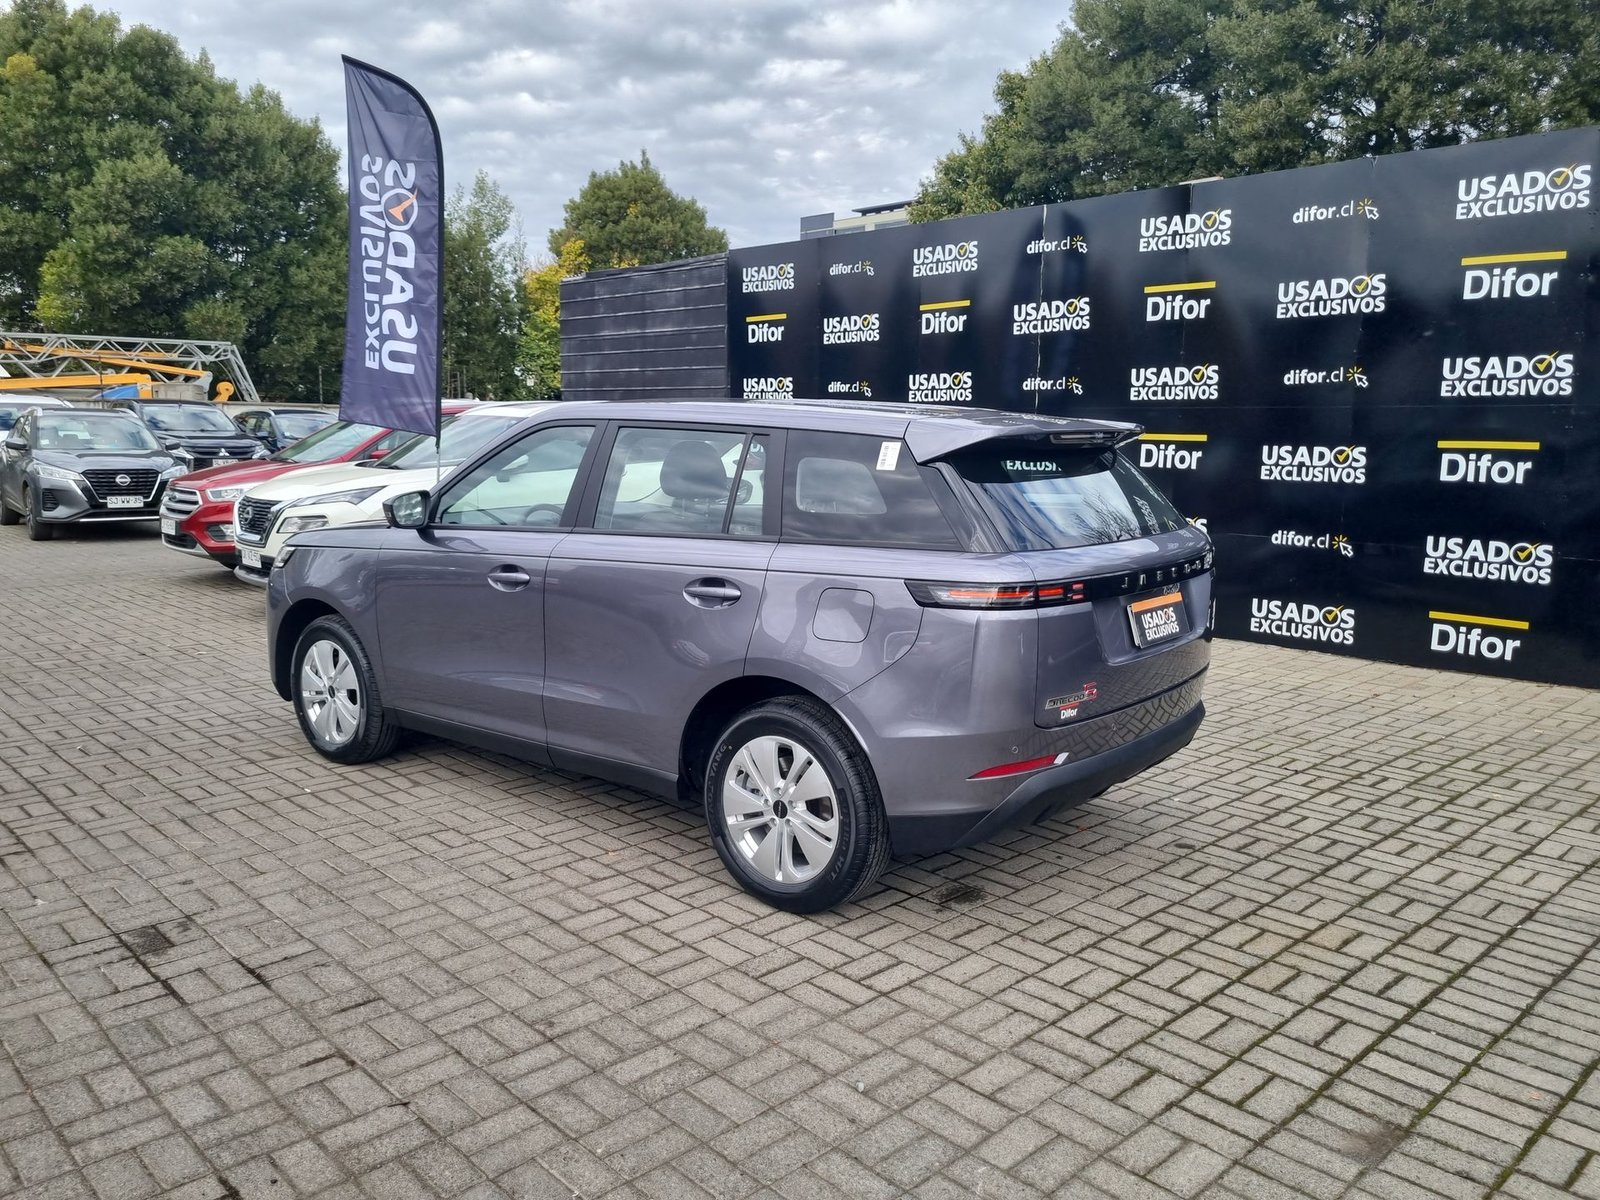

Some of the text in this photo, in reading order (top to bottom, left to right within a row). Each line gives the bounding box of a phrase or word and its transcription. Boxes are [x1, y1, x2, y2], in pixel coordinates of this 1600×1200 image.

[1458, 164, 1592, 201] USADOS
[1293, 201, 1354, 224] difor.cl
[1456, 190, 1590, 220] EXCLUSIVOS
[1140, 208, 1232, 236] USADOS
[1026, 236, 1070, 255] difor.cl
[1139, 231, 1231, 252] EXCLUSIVOS
[913, 241, 978, 265] USADOS
[742, 263, 794, 282] USADOS
[830, 262, 862, 276] difor.cl
[913, 259, 978, 277] EXCLUSIVOS
[742, 278, 794, 293] EXCLUSIVOS
[1278, 274, 1386, 302] USADOS
[1463, 268, 1558, 300] Difor
[1013, 297, 1090, 322] USADOS
[1146, 295, 1210, 322] Difor
[1276, 296, 1385, 318] EXCLUSIVOS
[748, 323, 784, 343] Difor
[824, 314, 880, 333] USADOS
[921, 312, 967, 334] Difor
[1013, 316, 1090, 335] EXCLUSIVOS
[824, 329, 880, 344] EXCLUSIVOS
[1130, 364, 1218, 386] USADOS
[1284, 367, 1344, 384] difor.cl
[1442, 352, 1574, 379] USADOS
[744, 377, 793, 392] USADOS
[828, 380, 859, 393] difor.cl
[909, 372, 972, 390] USADOS
[1023, 376, 1066, 392] difor.cl
[1440, 379, 1573, 396] EXCLUSIVOS
[909, 388, 972, 402] EXCLUSIVOS
[1130, 384, 1218, 400] EXCLUSIVOS
[1006, 460, 1062, 471] EXCLUSI
[1140, 444, 1202, 470] Difor
[1262, 445, 1367, 467] USADOS
[1260, 466, 1366, 484] EXCLUSIVOS
[1440, 453, 1532, 484] Difor
[1272, 530, 1330, 549] difor.cl
[1426, 536, 1554, 567] USADOS
[1424, 558, 1552, 584] EXCLUSIVOS
[1142, 607, 1176, 628] USADOS
[1252, 598, 1356, 628] USADOS
[1145, 622, 1179, 640] EXCLUSIVOS
[1250, 616, 1354, 645] EXCLUSIVOS
[1430, 623, 1520, 660] Difor
